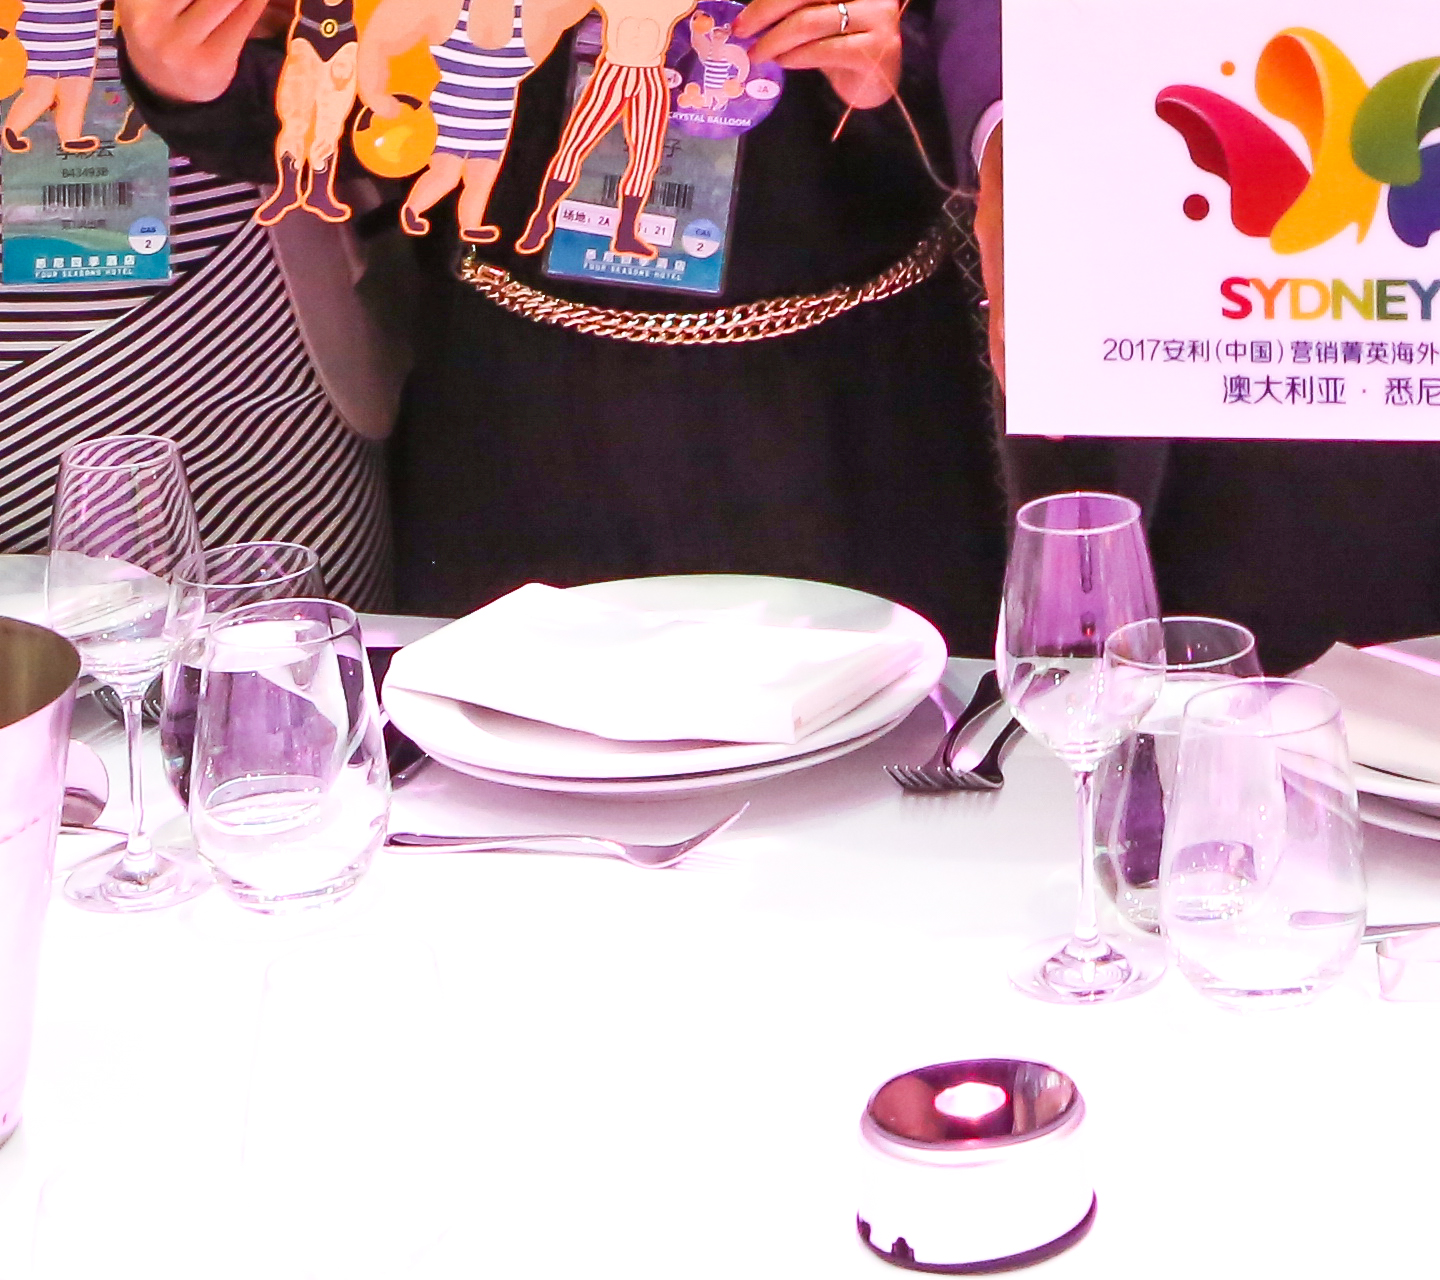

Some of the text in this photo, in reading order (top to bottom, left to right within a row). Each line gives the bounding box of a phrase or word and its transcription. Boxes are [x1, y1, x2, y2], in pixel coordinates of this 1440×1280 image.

[597, 216, 610, 227] 2A
[654, 225, 667, 236] 21
[145, 239, 152, 249] 2
[696, 243, 704, 252] 2
